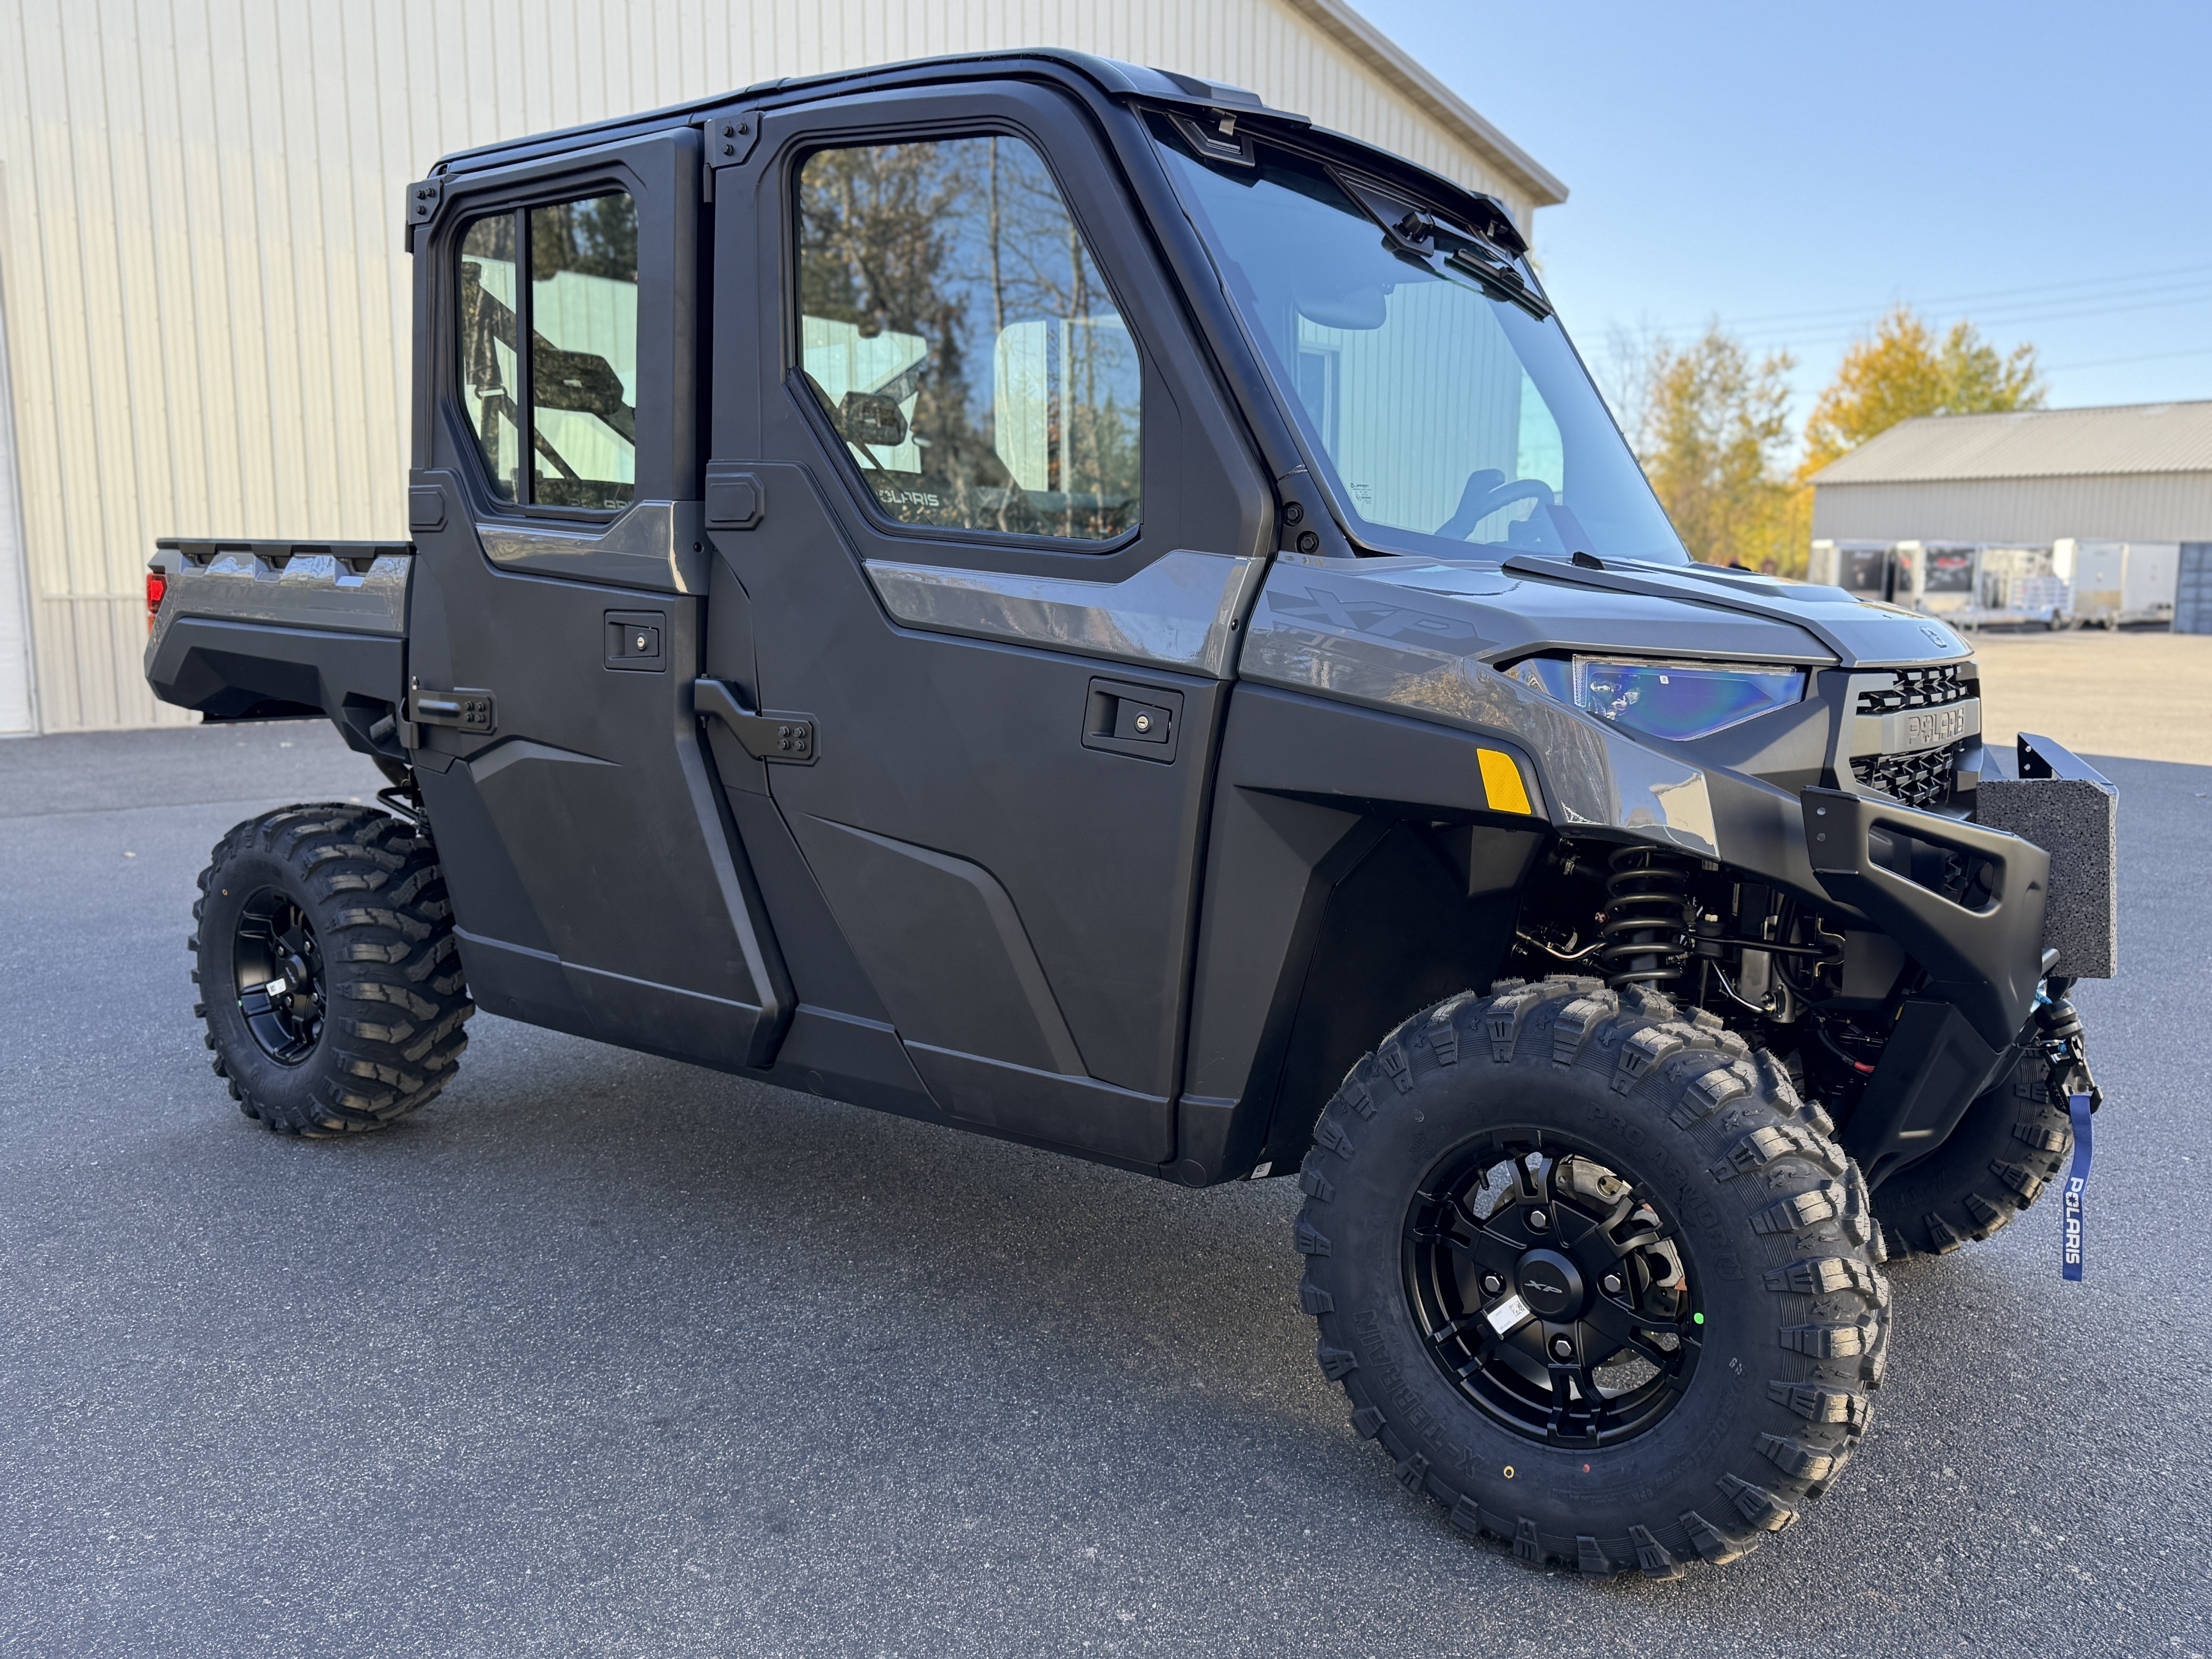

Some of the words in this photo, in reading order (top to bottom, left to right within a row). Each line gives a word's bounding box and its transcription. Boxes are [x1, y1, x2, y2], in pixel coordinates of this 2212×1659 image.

[875, 489, 939, 507] OLARIS
[1267, 586, 1480, 638] XP
[1587, 1101, 1646, 1147] PRO
[1645, 1146, 1728, 1249] ARMOR
[2065, 1176, 2084, 1265] POLARIS
[1524, 1280, 1563, 1293] XP
[1352, 1309, 1486, 1479] X-TERRAIN
